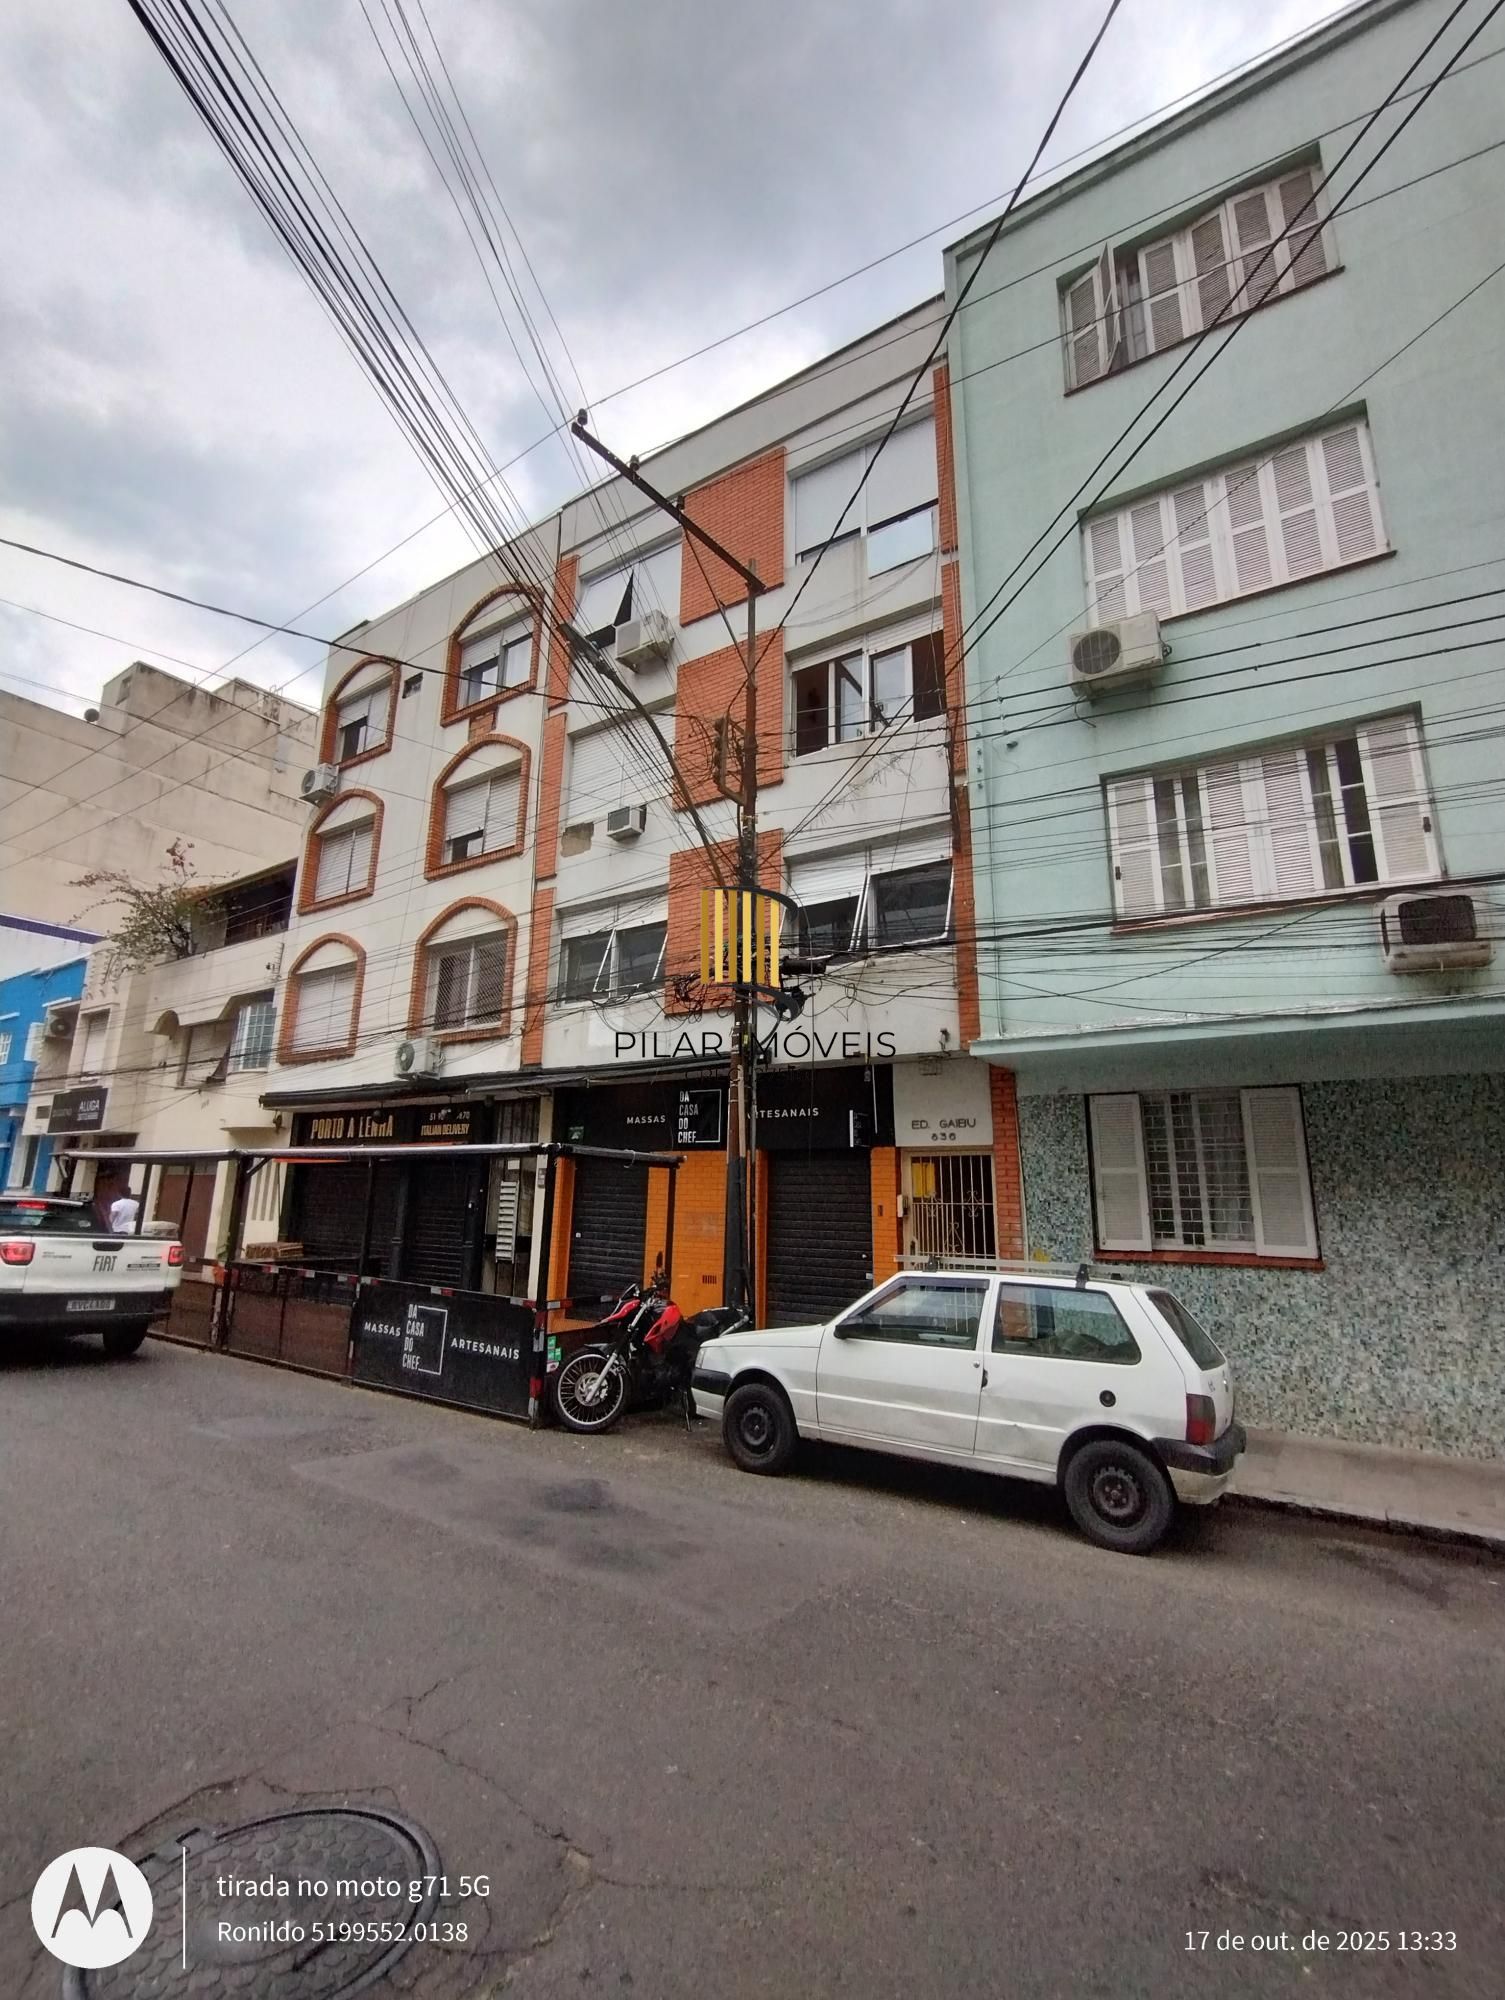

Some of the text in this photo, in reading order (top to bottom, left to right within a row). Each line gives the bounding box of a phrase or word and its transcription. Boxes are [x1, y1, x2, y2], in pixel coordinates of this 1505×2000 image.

[679, 1090, 690, 1102] DA
[79, 1100, 100, 1112] ALUGA
[679, 1103, 699, 1116] CASA
[626, 1115, 666, 1125] MASSAS
[678, 1117, 689, 1129] DO
[911, 1118, 977, 1130] ED. GAIBU
[310, 1117, 345, 1140] PORTO
[347, 1117, 355, 1139] A
[442, 1123, 470, 1135] DELIVERY
[678, 1131, 697, 1143] CHEF
[92, 1255, 118, 1272] FIAT
[408, 1304, 418, 1319] DA
[364, 1321, 401, 1337] MASSAS
[406, 1320, 425, 1337] CASA
[404, 1337, 414, 1352] DO
[450, 1337, 520, 1360] ARTESANAIS
[402, 1353, 420, 1371] CHEF
